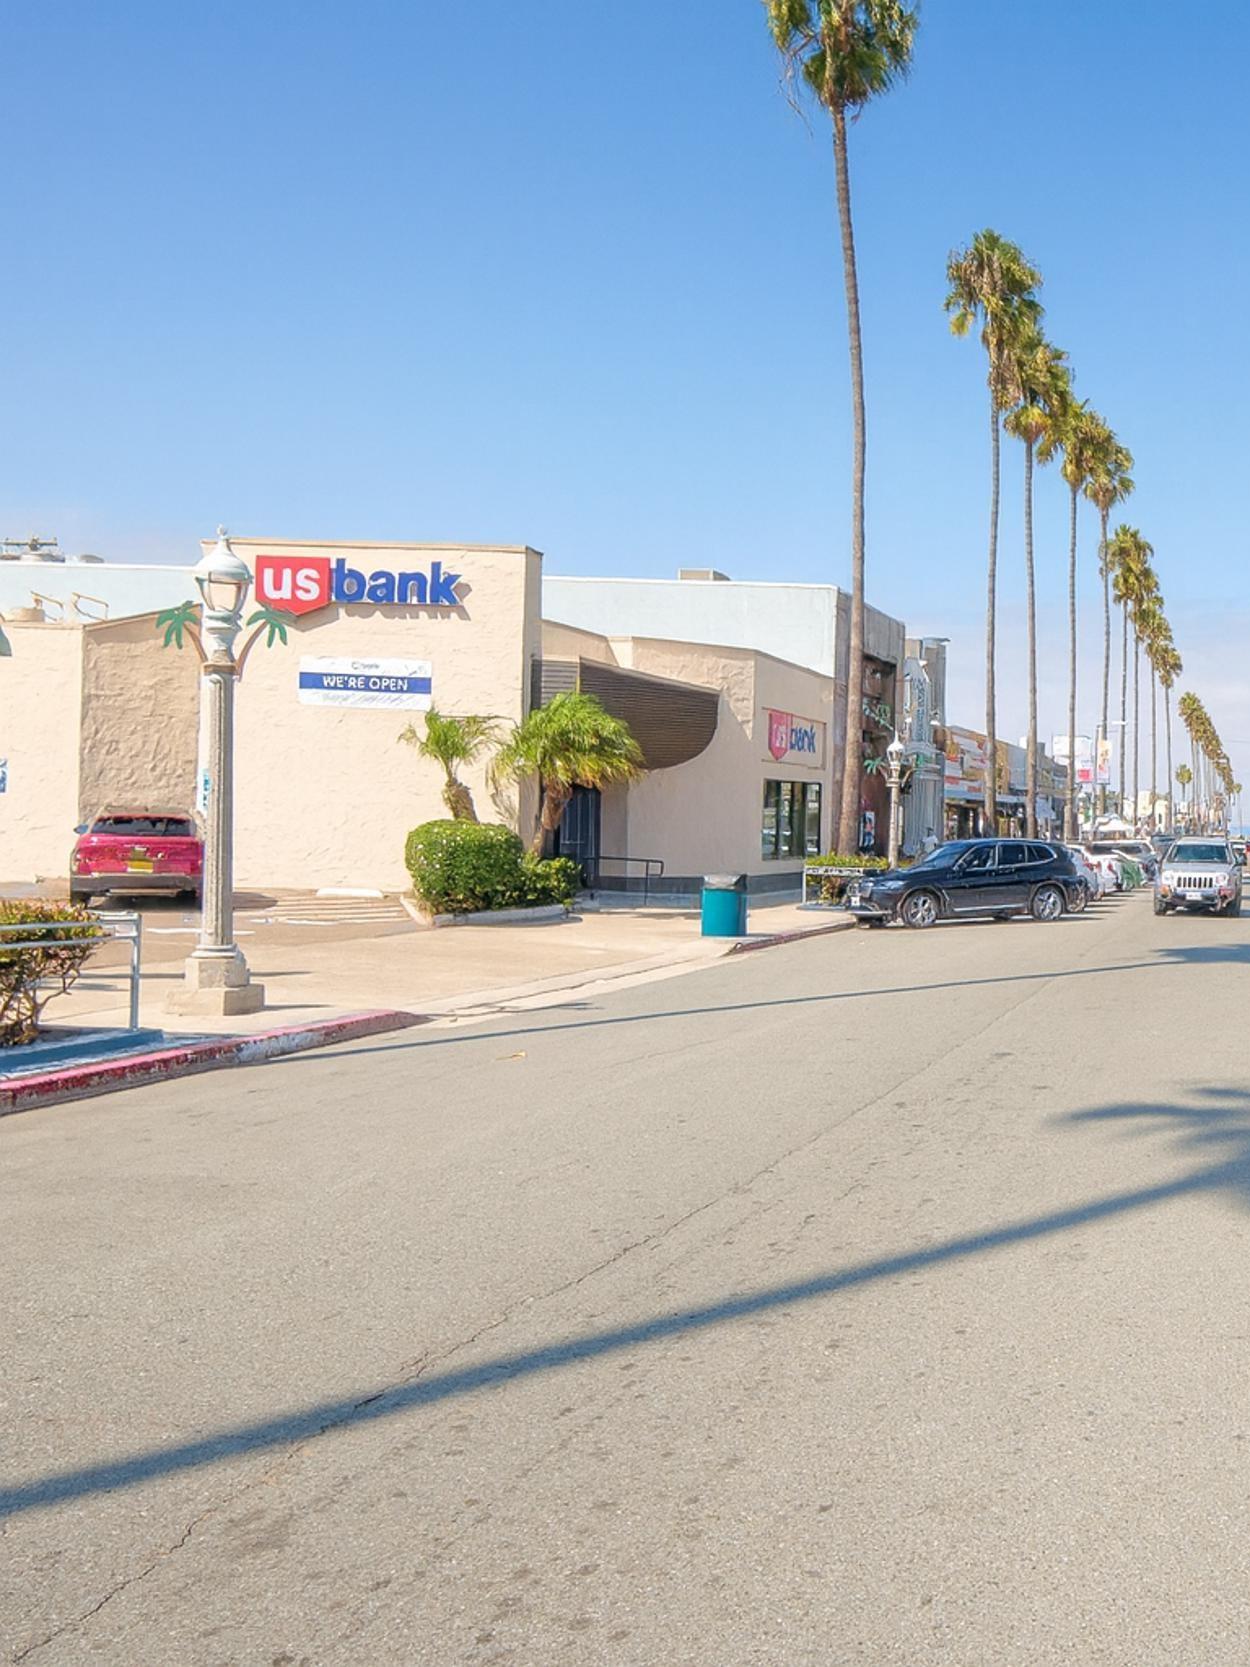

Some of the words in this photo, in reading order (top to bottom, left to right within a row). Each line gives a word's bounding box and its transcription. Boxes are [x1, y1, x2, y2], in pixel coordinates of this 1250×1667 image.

[262, 567, 321, 601] us
[334, 557, 463, 606] bank
[322, 674, 366, 690] WE'RE
[368, 676, 409, 692] OPEN
